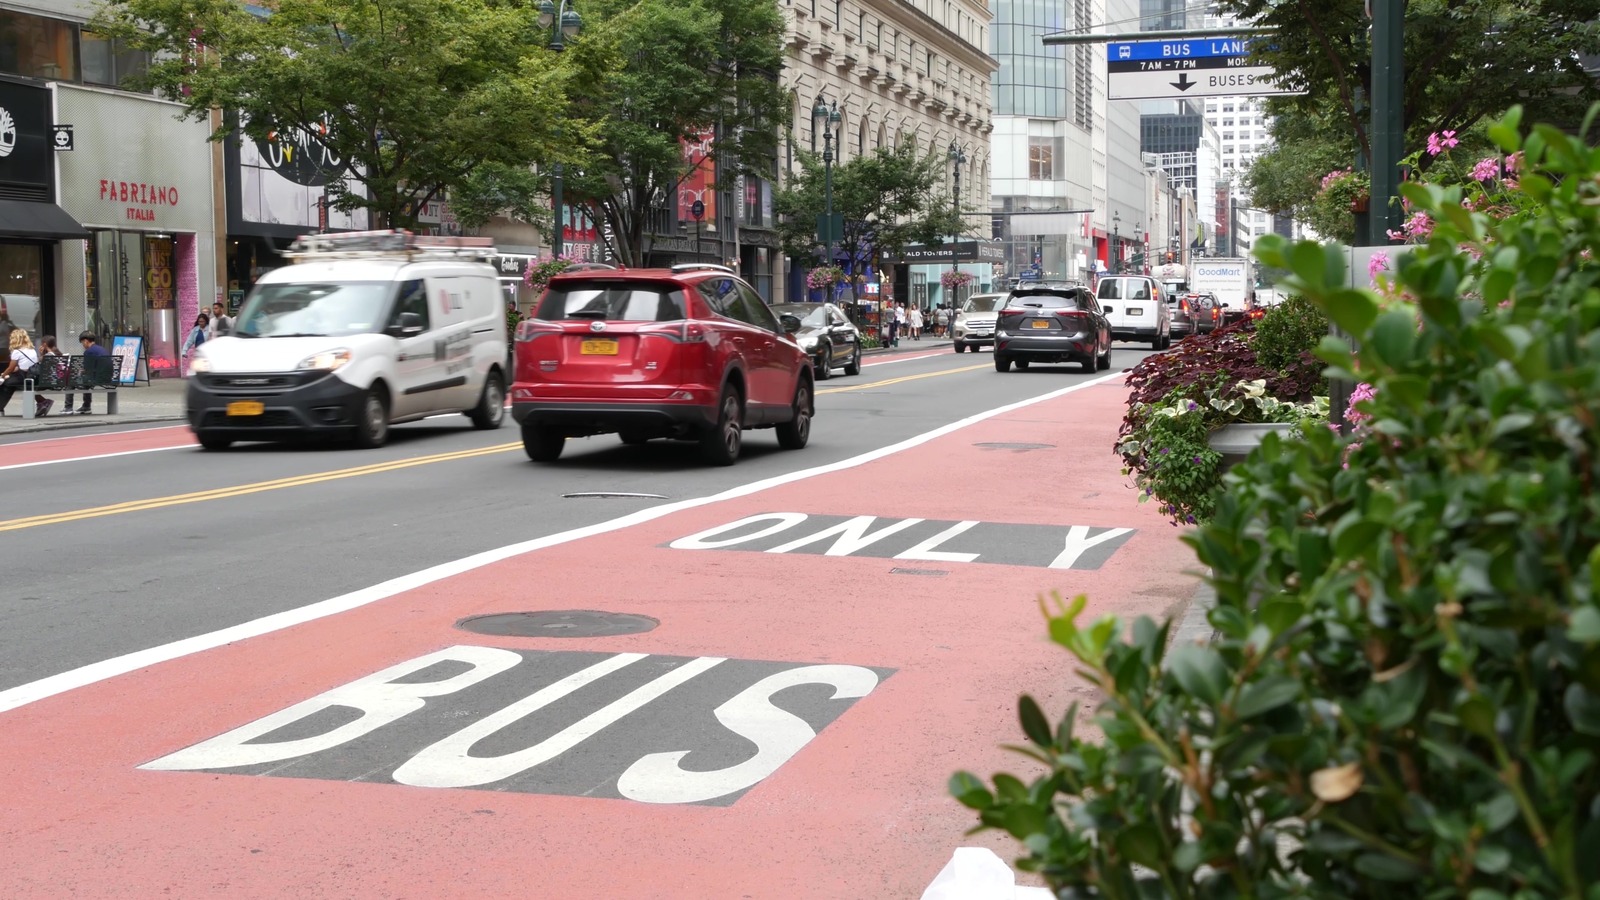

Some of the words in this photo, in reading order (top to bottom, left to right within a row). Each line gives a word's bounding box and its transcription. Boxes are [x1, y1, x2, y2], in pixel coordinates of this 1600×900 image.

[1163, 44, 1190, 56] BUS
[1212, 41, 1249, 54] LANE
[1174, 61, 1180, 69] 7
[1183, 60, 1196, 68] PM
[1209, 74, 1254, 87] BUSES
[100, 179, 178, 206] FABRIANO
[126, 207, 155, 221] ITALIA
[147, 268, 172, 288] GO
[1198, 268, 1241, 276] GoodMart
[670, 512, 1134, 569] ONLY
[135, 644, 880, 804] BUS
